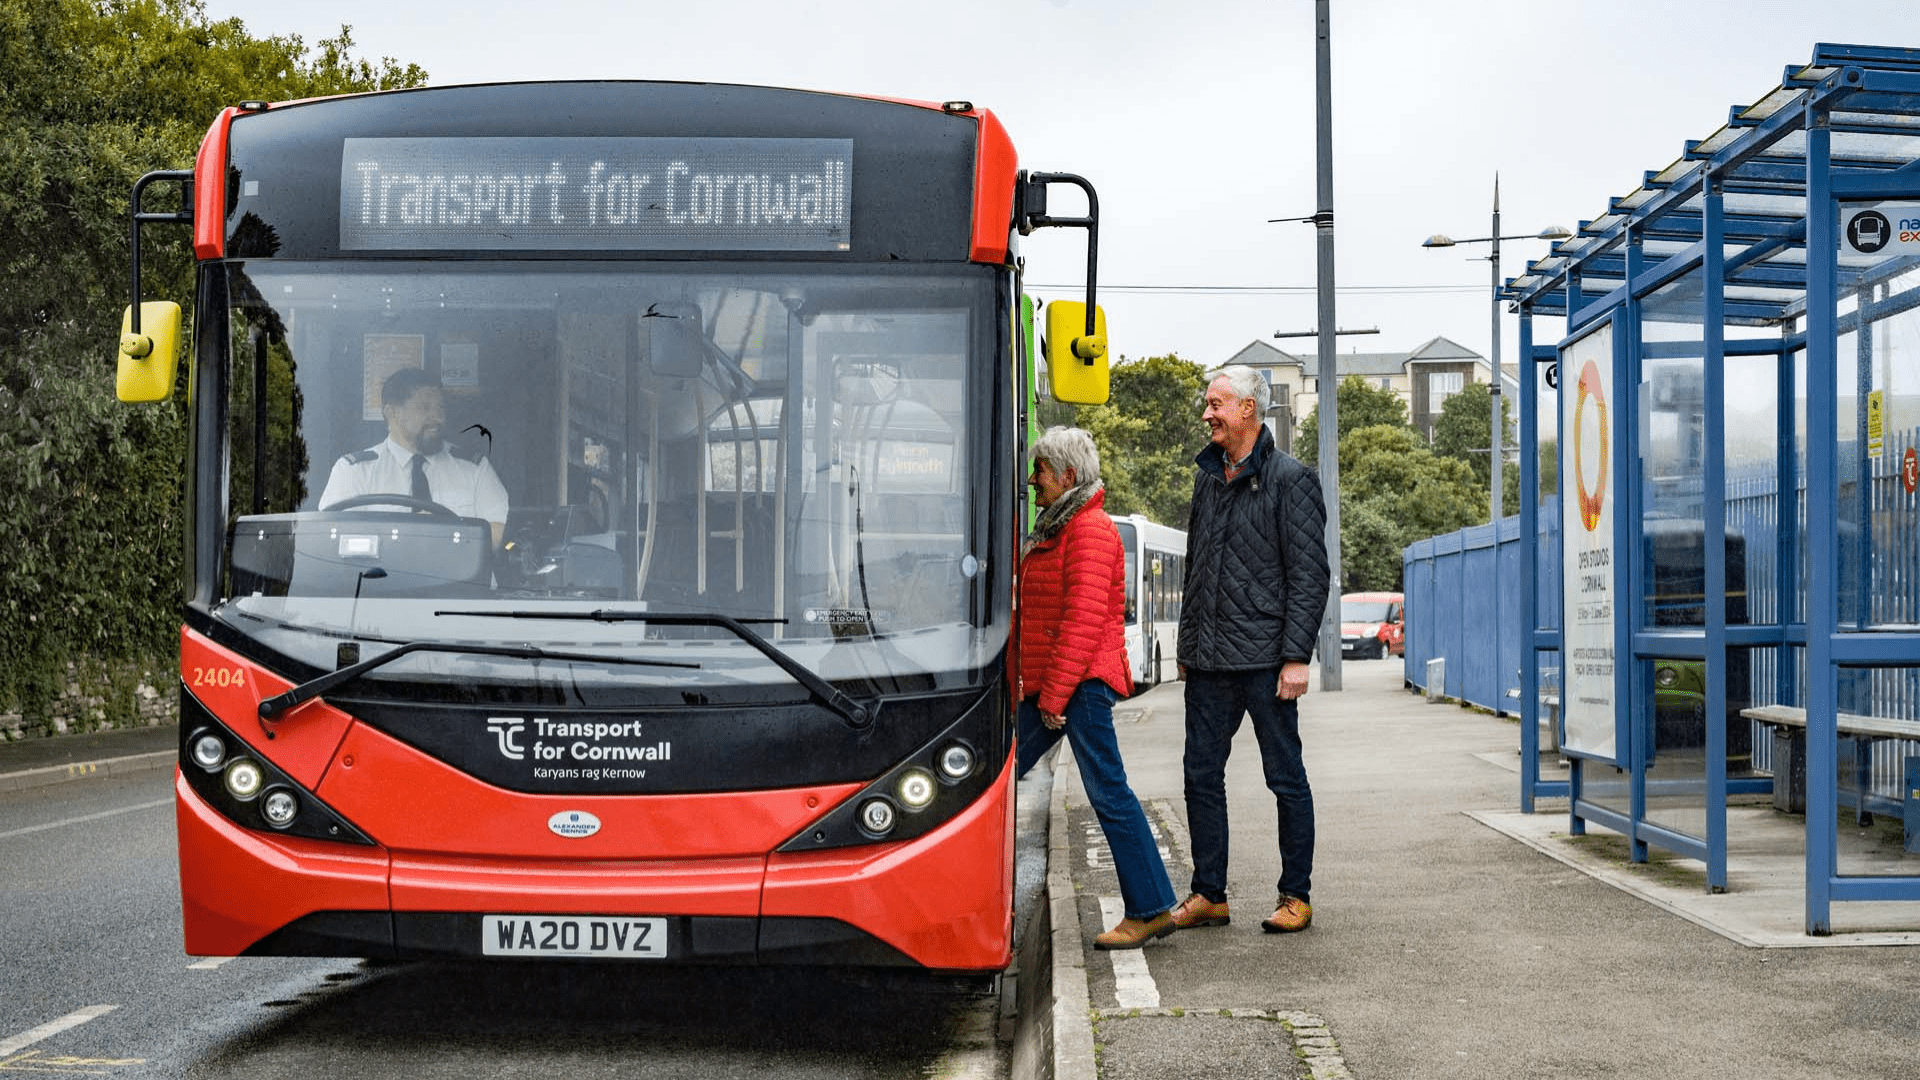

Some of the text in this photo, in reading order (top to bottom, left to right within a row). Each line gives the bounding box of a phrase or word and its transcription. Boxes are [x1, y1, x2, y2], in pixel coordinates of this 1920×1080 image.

[356, 160, 845, 225] Transport for Cornwall
[193, 667, 245, 687] 2404
[533, 718, 642, 741] Transport
[533, 741, 671, 761] for Cornwall
[533, 767, 646, 780] Karyans rag Kernow
[497, 920, 652, 952] WA20 DVZ
